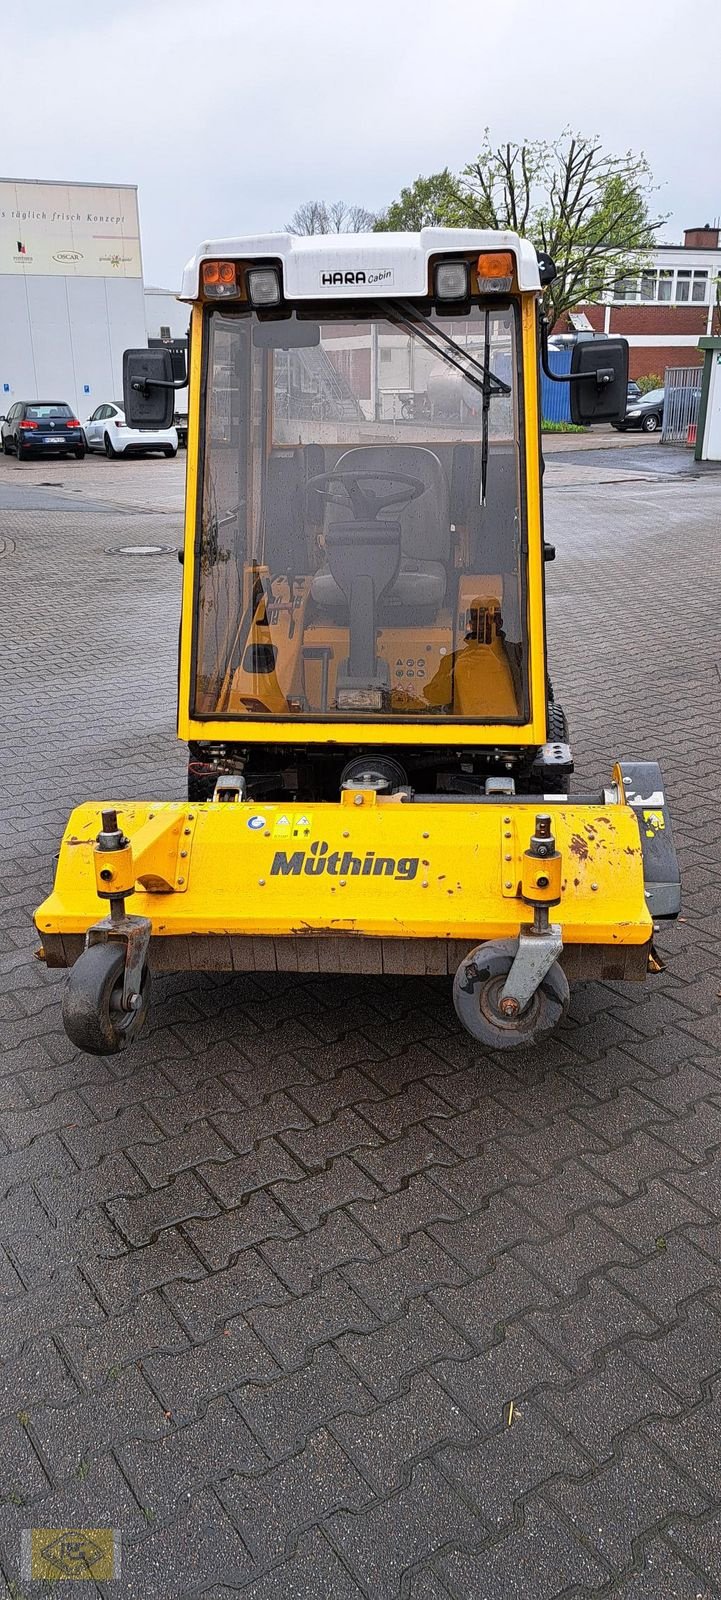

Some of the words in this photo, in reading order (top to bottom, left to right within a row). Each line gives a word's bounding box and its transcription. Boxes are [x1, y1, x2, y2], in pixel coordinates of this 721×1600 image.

[11, 210, 47, 220] täglich
[51, 211, 81, 222] frisch
[87, 213, 125, 224] Konzept
[56, 253, 80, 261] OSCAR
[322, 271, 366, 285] HARA
[367, 270, 391, 284] Cabin
[270, 841, 420, 881] Müthing
